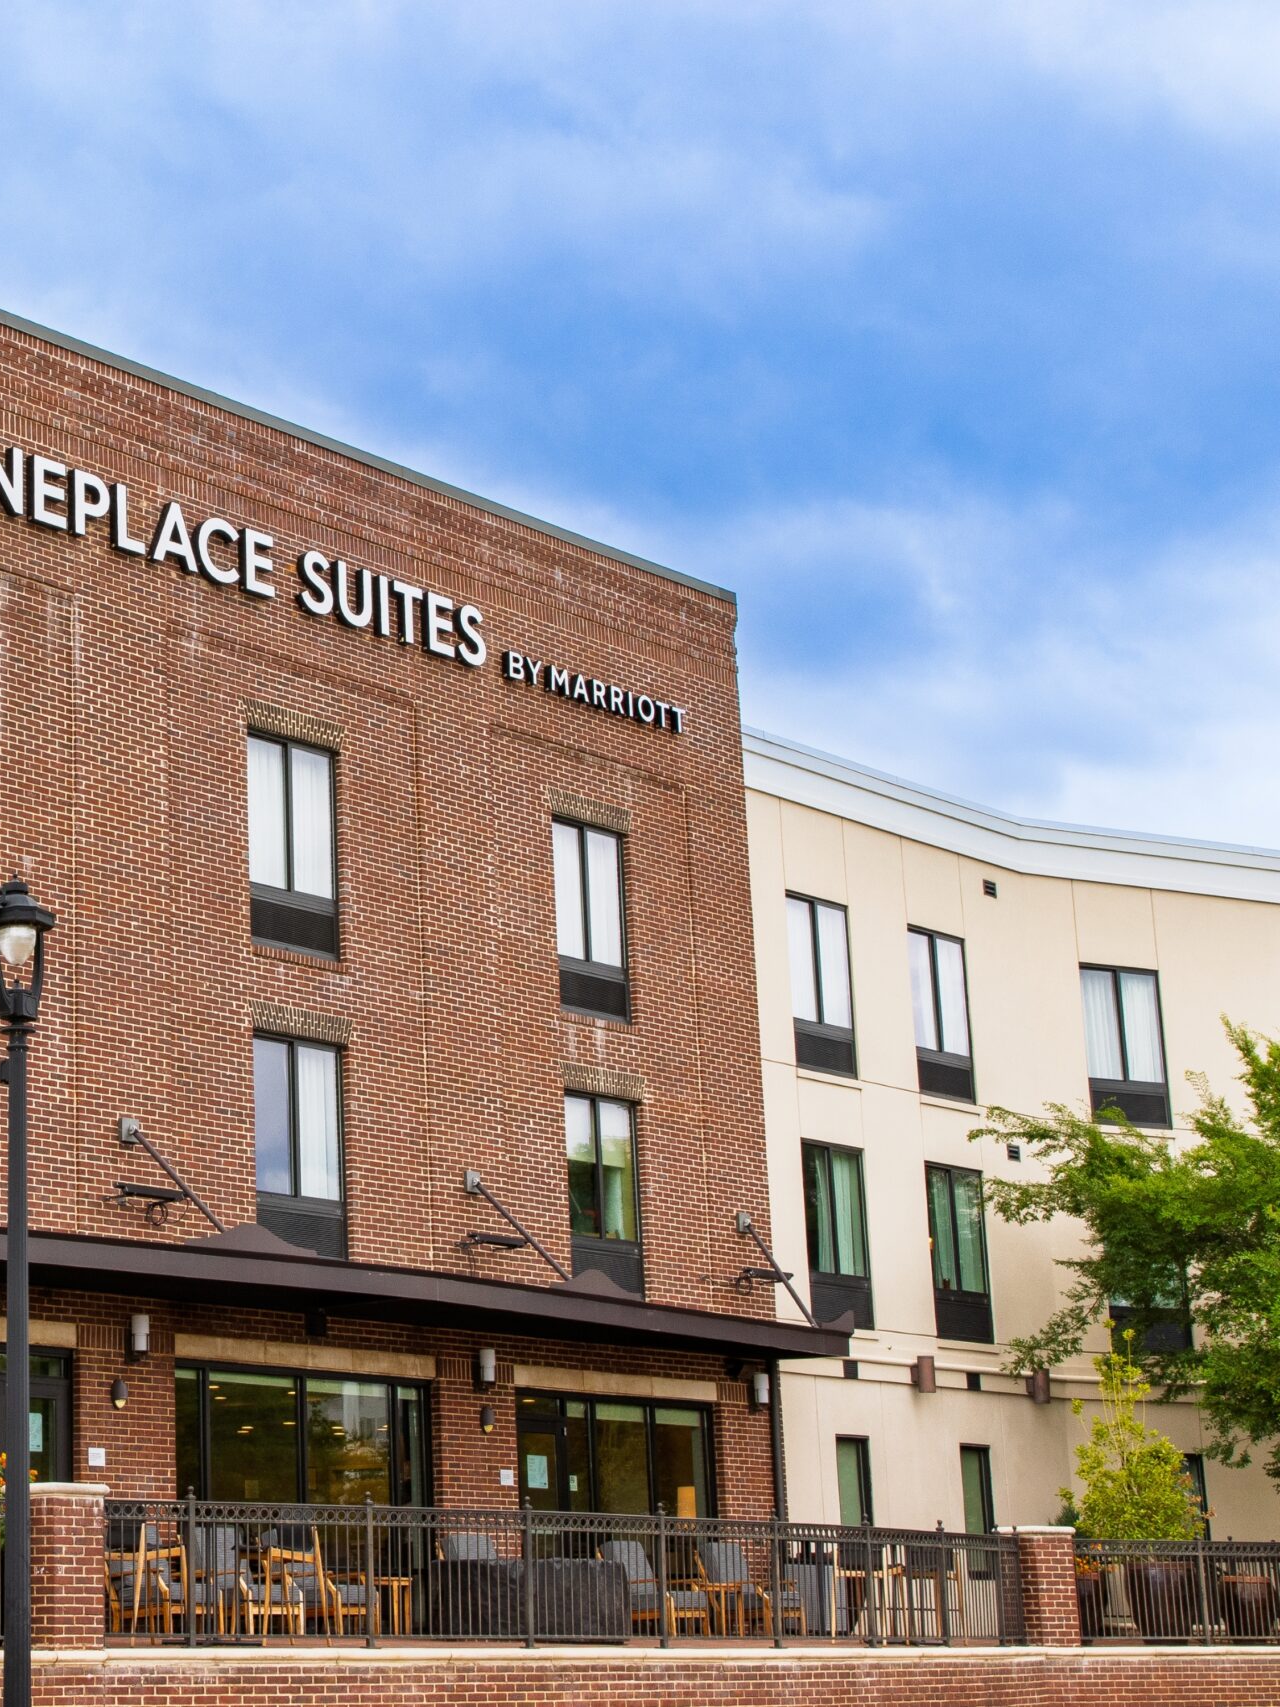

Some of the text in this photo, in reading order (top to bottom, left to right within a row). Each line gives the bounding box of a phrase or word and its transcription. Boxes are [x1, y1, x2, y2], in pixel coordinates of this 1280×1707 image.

[298, 550, 487, 666] SUITES
[505, 651, 542, 686] BY
[547, 665, 687, 734] MARRIOTT
